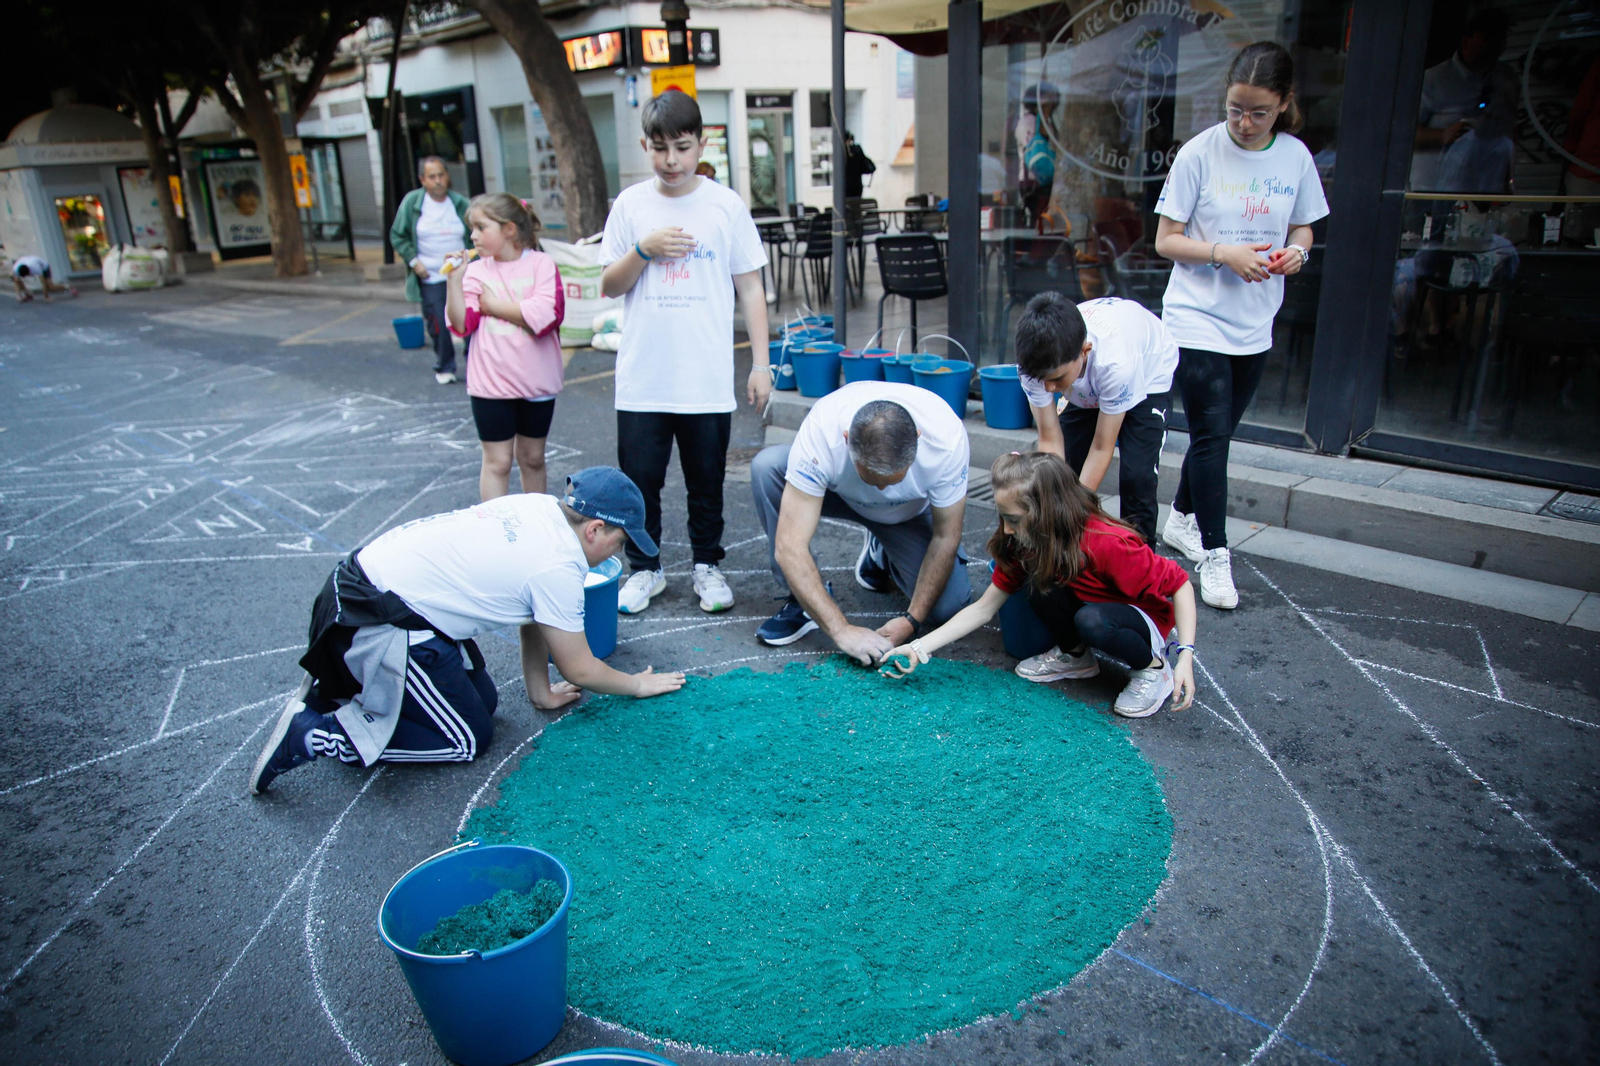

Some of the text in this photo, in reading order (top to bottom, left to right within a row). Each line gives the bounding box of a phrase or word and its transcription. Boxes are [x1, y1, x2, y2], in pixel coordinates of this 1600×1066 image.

[1091, 143, 1182, 172] Año 196
[1249, 177, 1260, 193] de
[595, 511, 626, 525] Real Madrid
